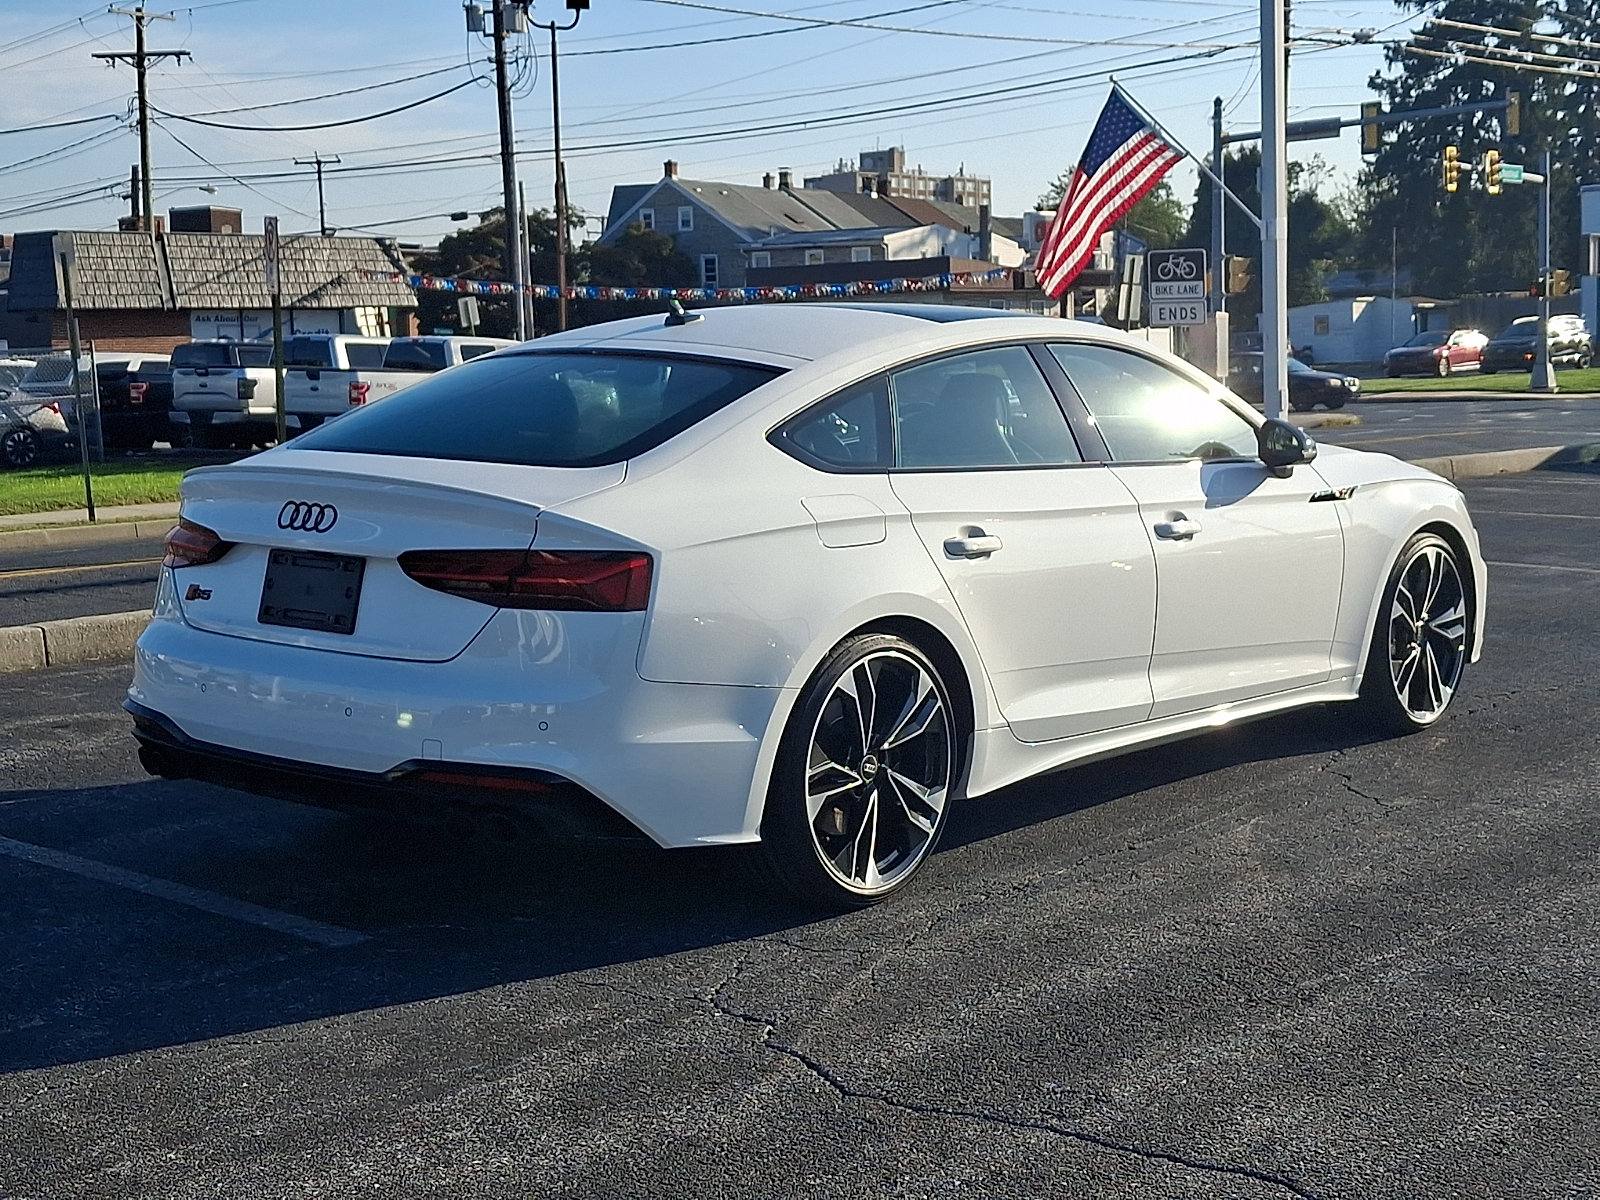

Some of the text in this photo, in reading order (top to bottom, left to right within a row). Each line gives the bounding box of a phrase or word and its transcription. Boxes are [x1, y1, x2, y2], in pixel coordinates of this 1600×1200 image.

[1155, 283, 1199, 296] BIKE LANE
[195, 314, 211, 322] Ask
[214, 314, 239, 322] About
[1159, 307, 1197, 320] ENDS
